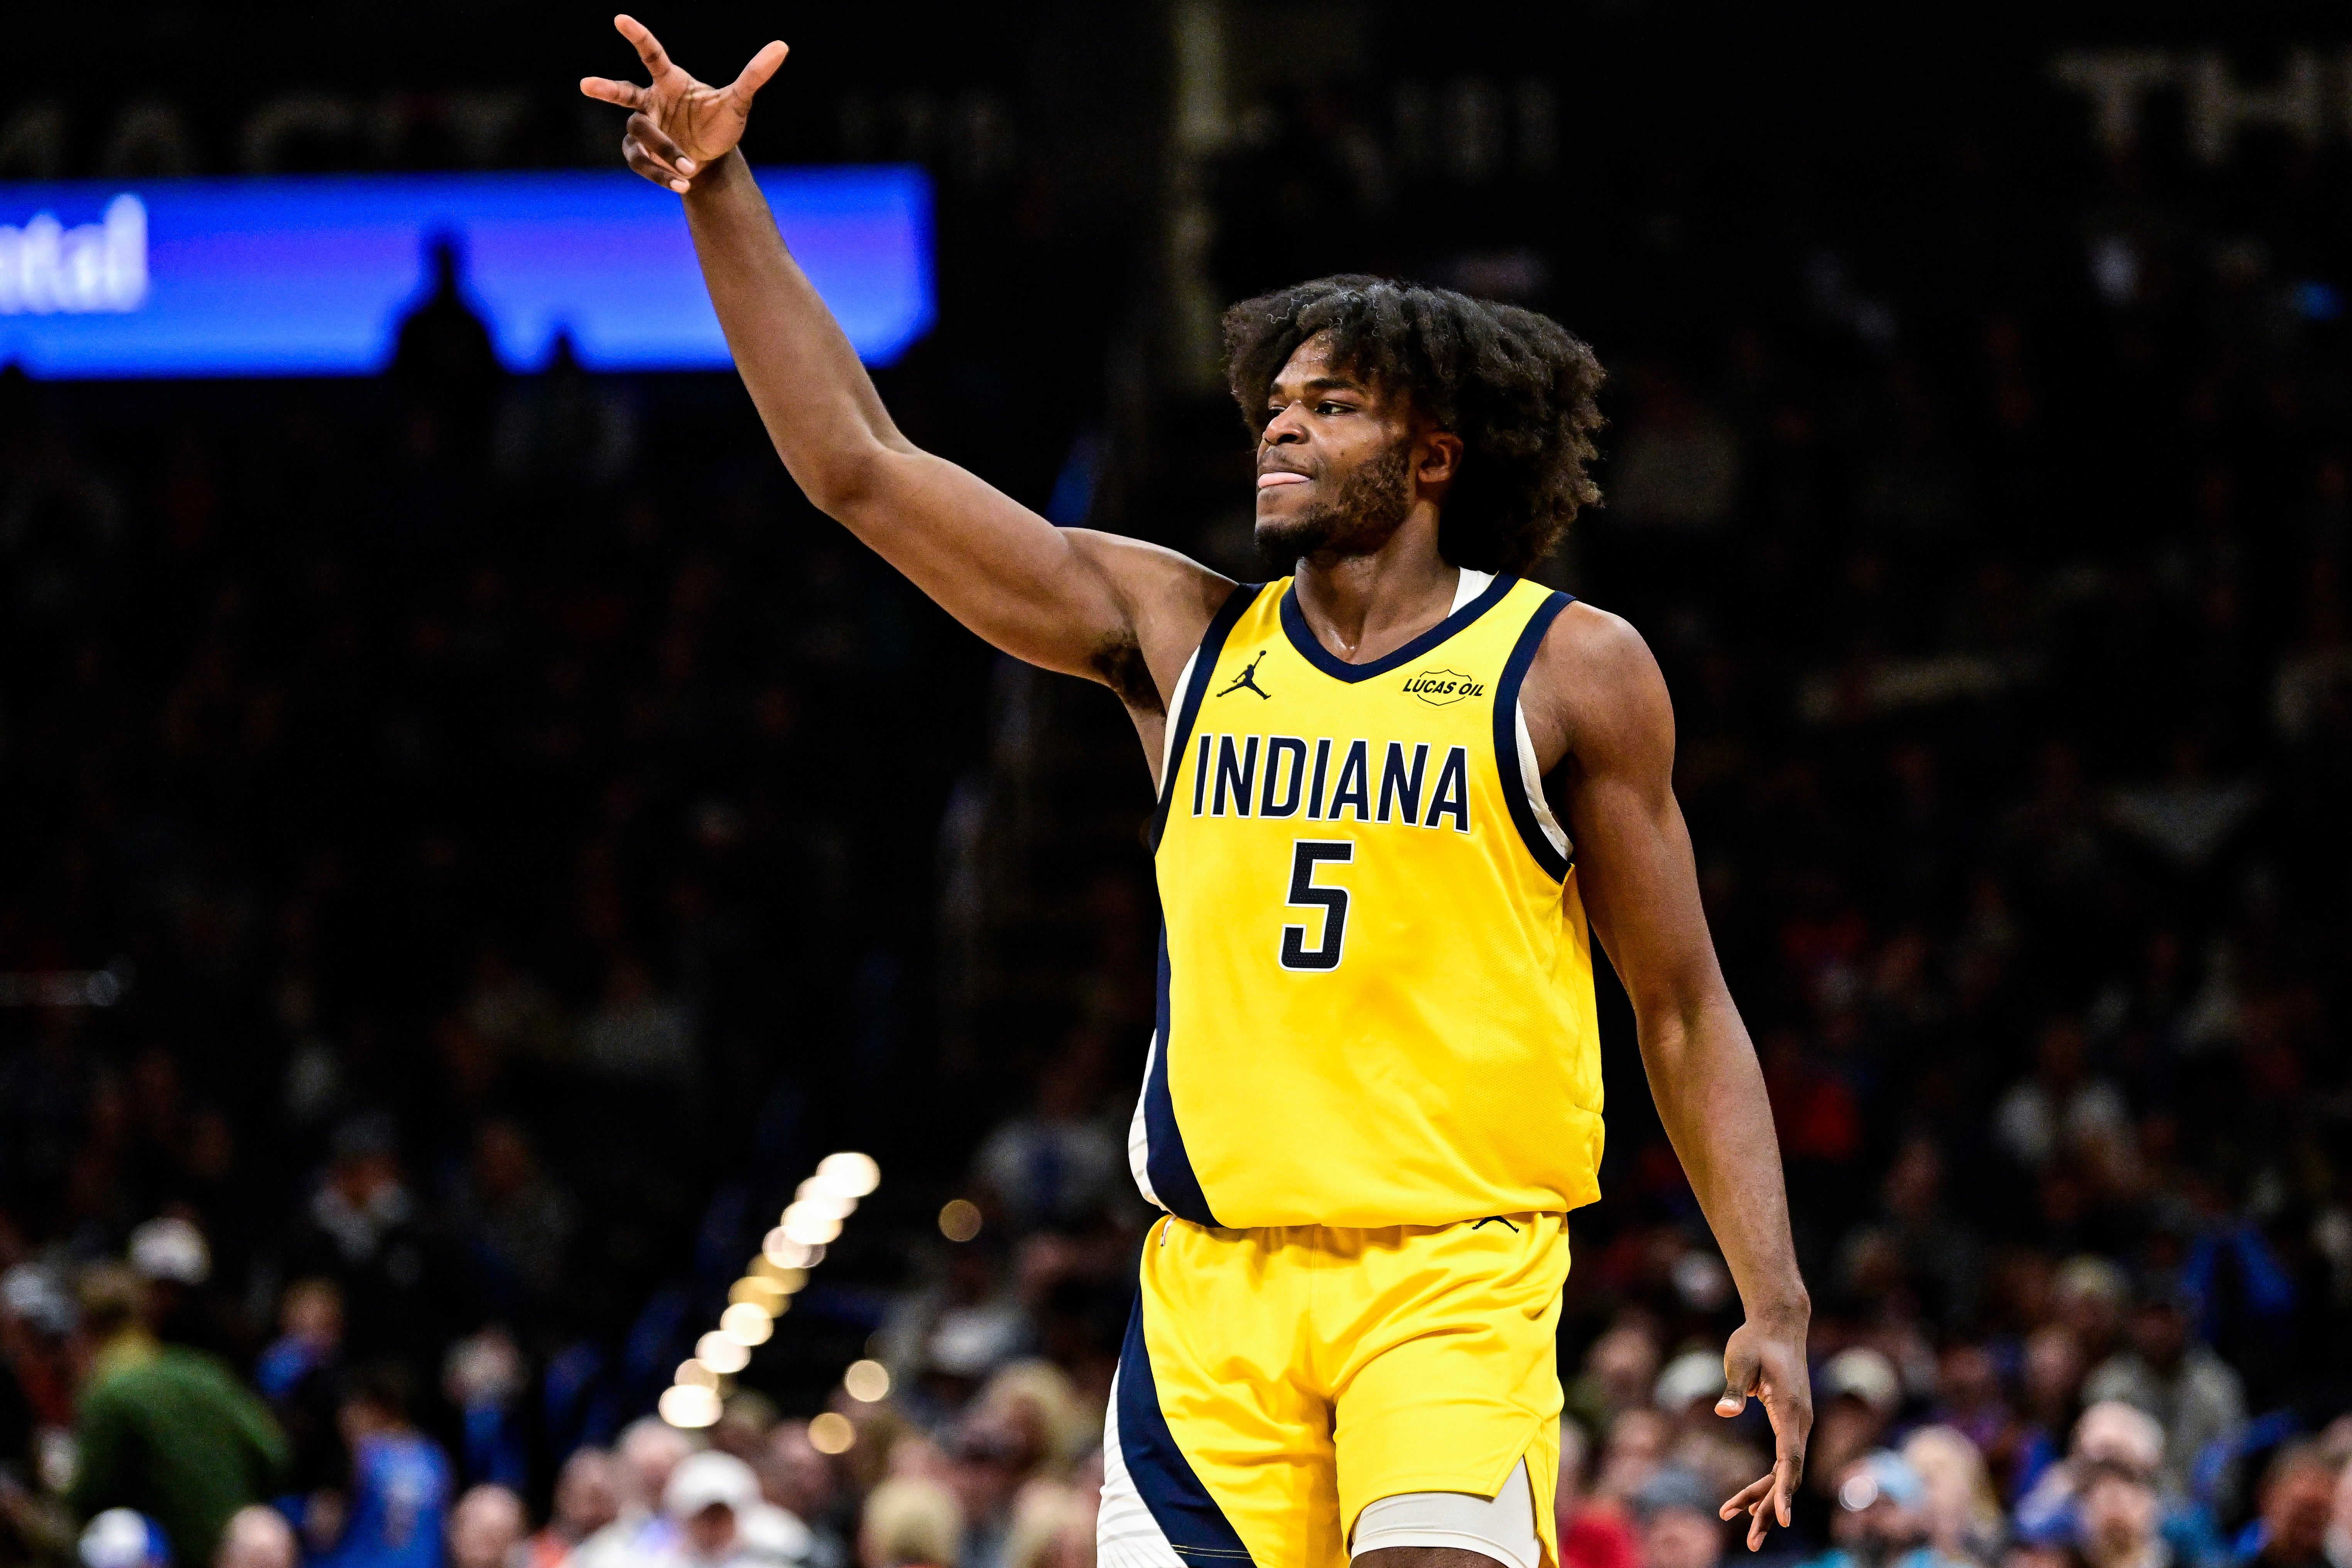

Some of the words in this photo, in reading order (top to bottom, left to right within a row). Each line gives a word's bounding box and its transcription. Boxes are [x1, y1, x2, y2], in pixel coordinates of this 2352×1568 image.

[1402, 679, 1457, 694] LUCAS
[1459, 683, 1484, 697] OIL
[1191, 733, 1471, 834] INDIANA
[1277, 839, 1355, 972] 5
